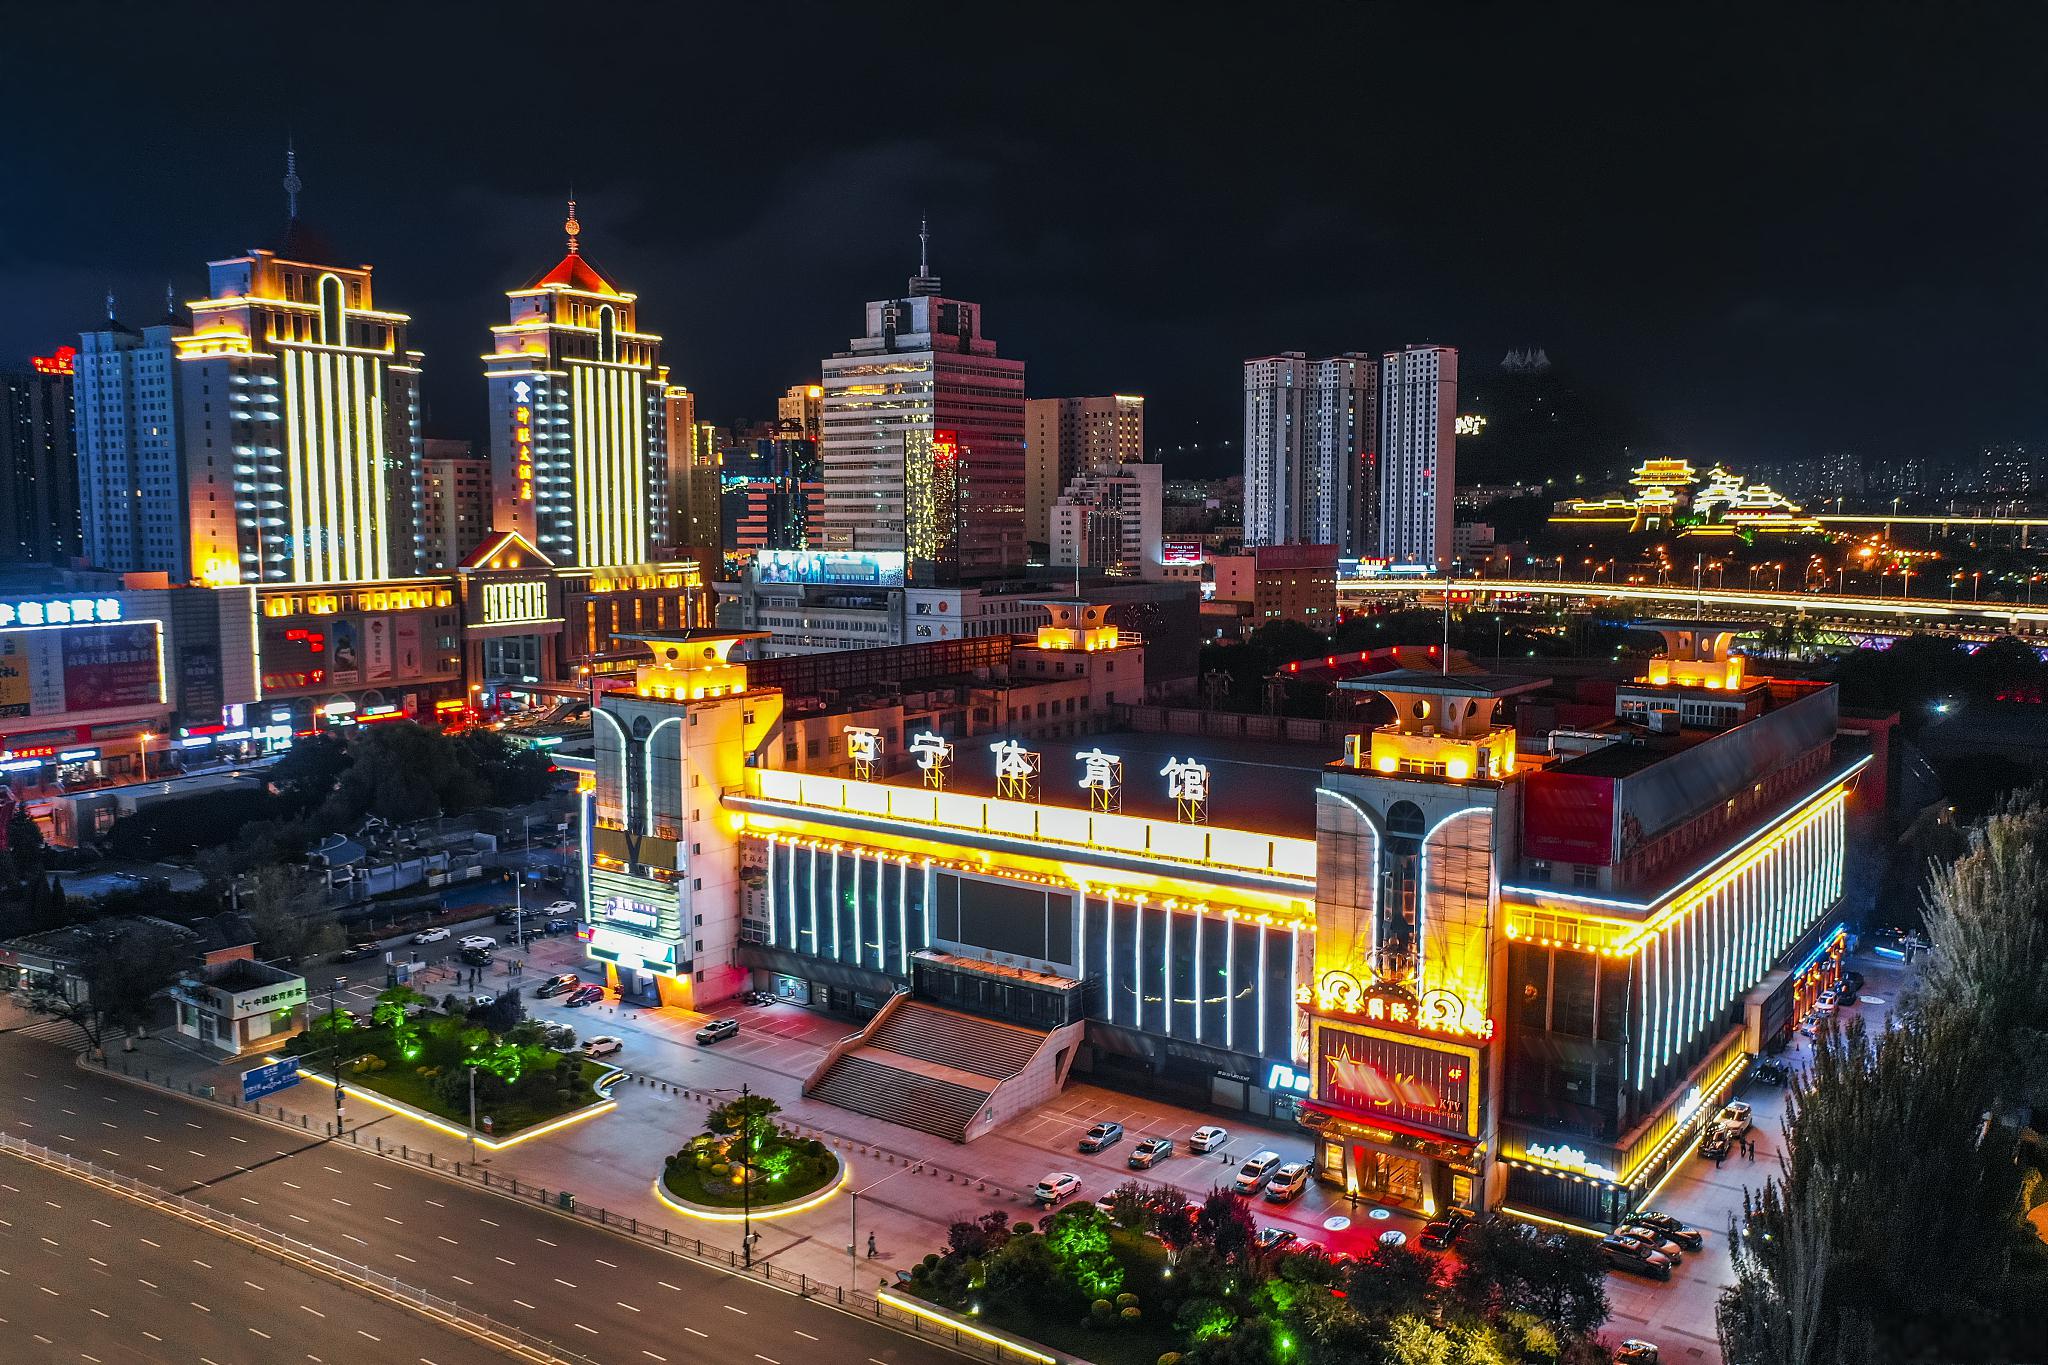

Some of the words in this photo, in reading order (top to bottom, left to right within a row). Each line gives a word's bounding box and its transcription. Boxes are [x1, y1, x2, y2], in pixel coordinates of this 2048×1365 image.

[843, 725, 1208, 801] 西宁体育馆
[253, 988, 303, 1007] 中国体育彩票
[1448, 1068, 1462, 1079] 4F
[1439, 1098, 1461, 1112] KTV
